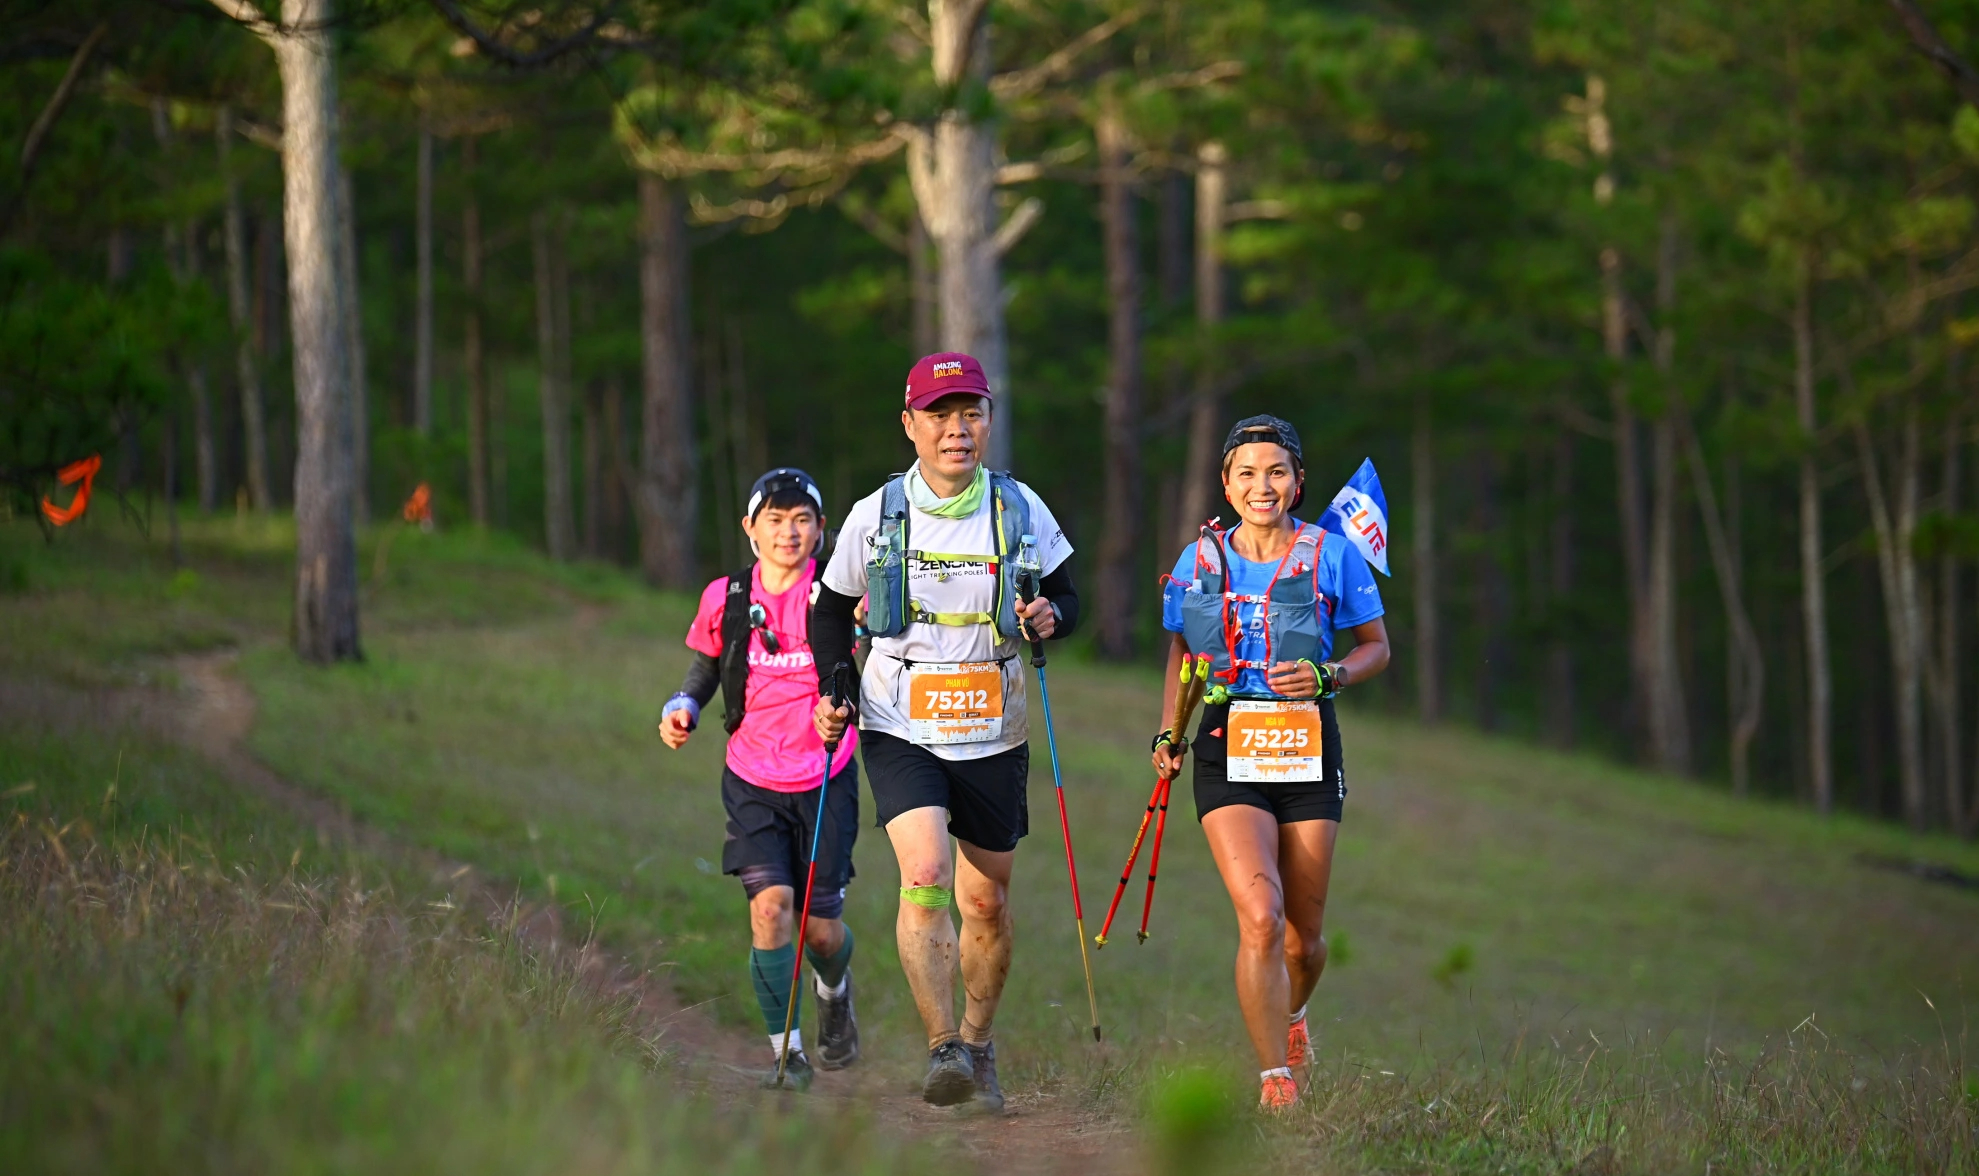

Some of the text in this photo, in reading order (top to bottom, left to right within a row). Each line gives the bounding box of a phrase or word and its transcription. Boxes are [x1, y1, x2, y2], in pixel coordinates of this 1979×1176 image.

[933, 361, 962, 371] AMAZING
[933, 368, 963, 379] HALONG
[1341, 497, 1386, 556] ELITE
[930, 570, 963, 578] TREKING
[1248, 631, 1265, 640] TRA
[747, 651, 815, 668] LUNTE
[970, 665, 989, 673] 75KM
[945, 678, 961, 688] PHAN
[925, 690, 988, 710] 75212
[1241, 728, 1309, 748] 75225
